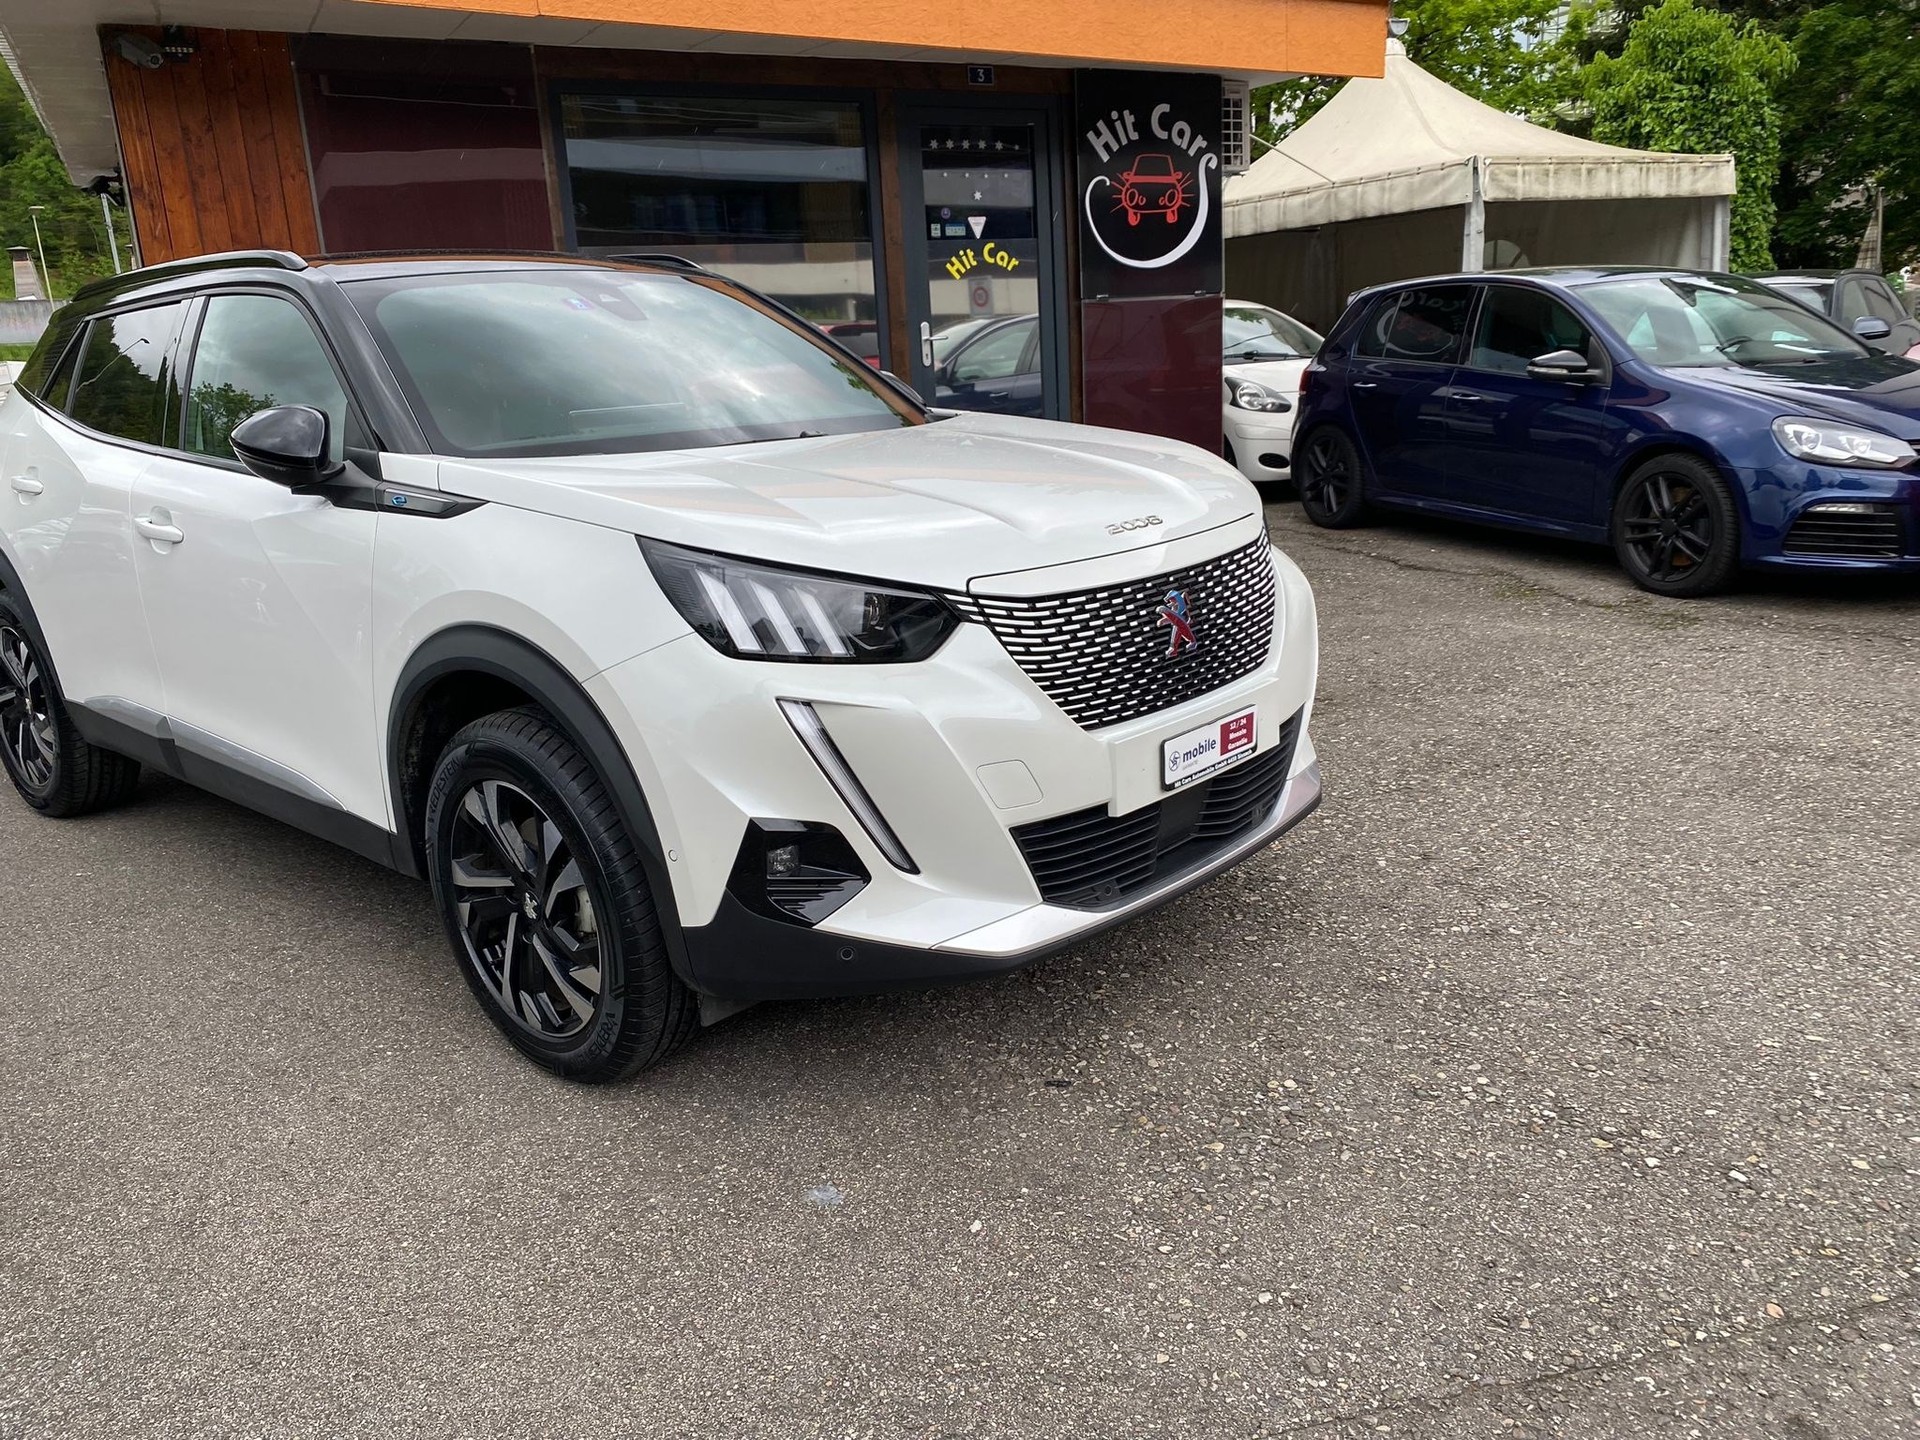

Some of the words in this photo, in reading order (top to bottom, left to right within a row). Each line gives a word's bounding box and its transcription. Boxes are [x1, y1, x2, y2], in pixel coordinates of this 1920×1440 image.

[976, 68, 985, 82] 3
[1086, 109, 1139, 163] Hit
[945, 248, 978, 280] Hit
[982, 242, 1019, 271] Car
[1105, 515, 1163, 535] 2008
[1182, 738, 1217, 763] mobile
